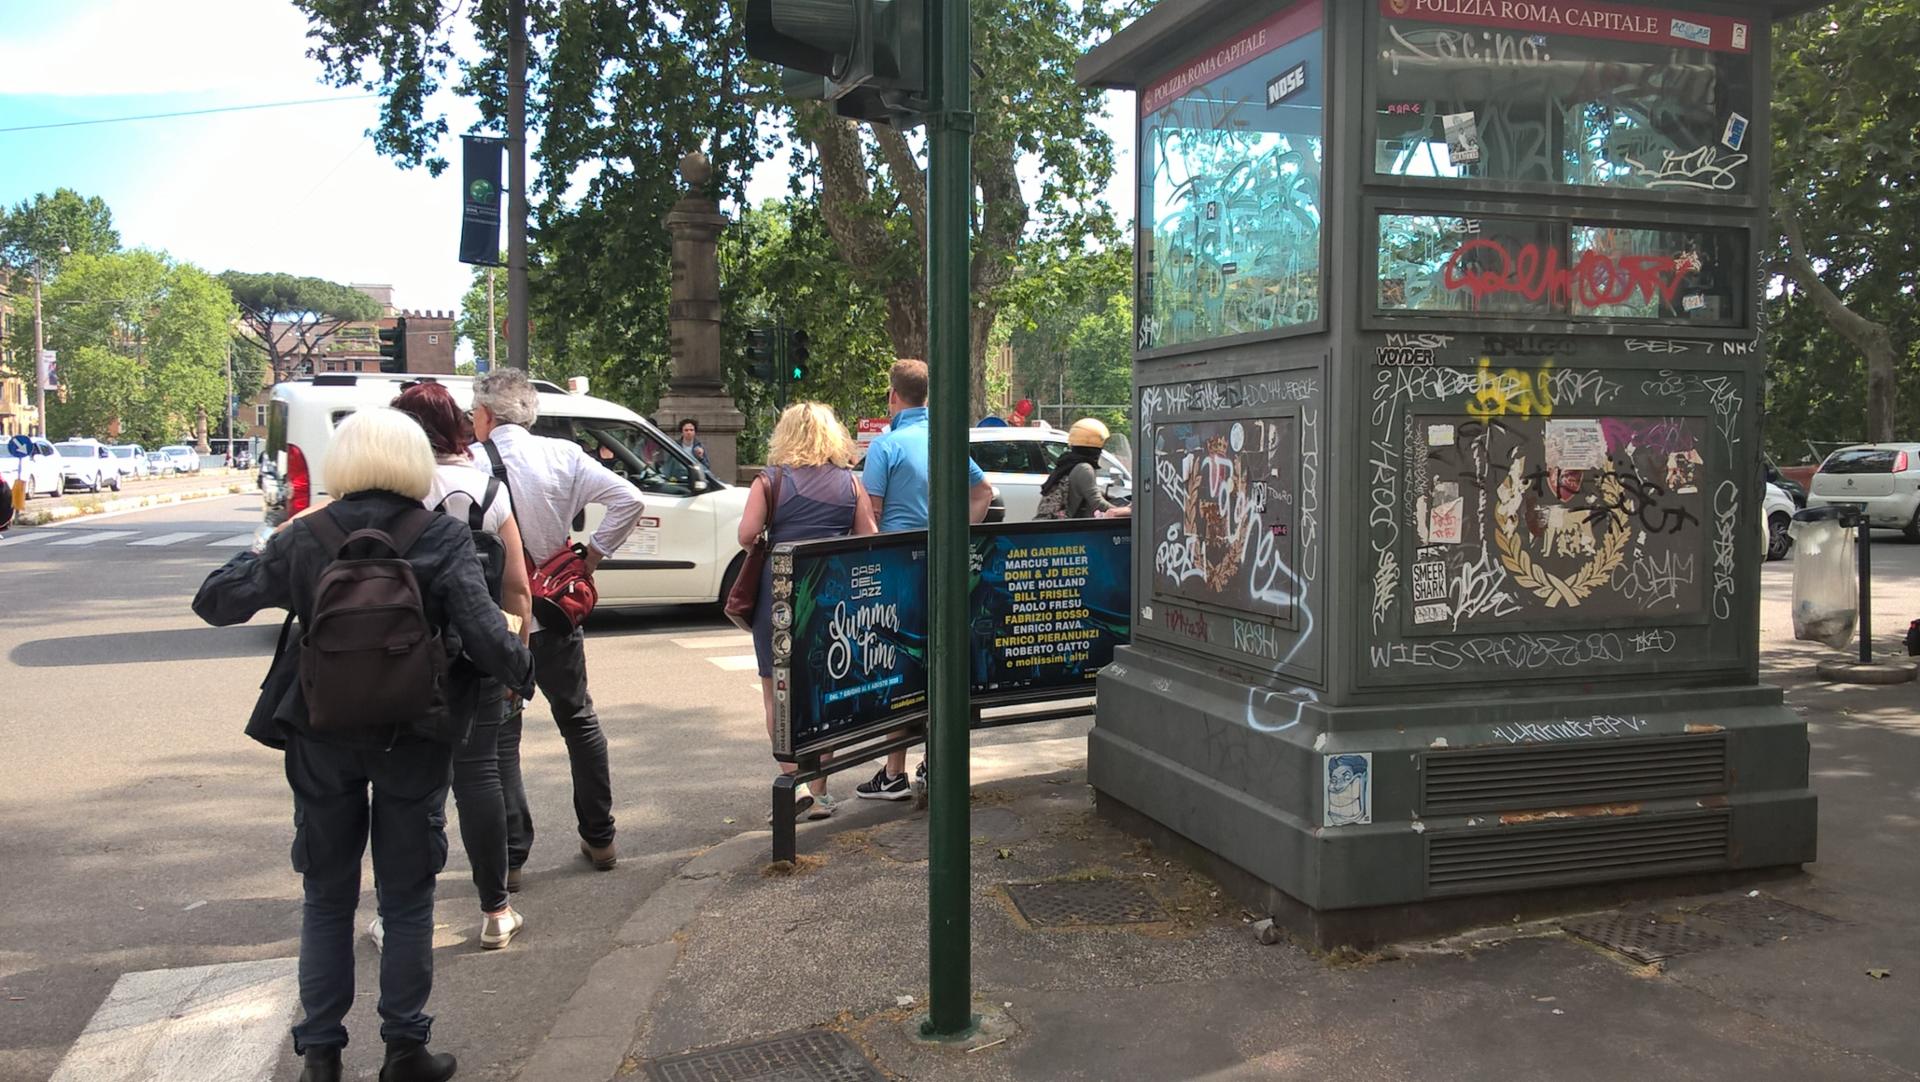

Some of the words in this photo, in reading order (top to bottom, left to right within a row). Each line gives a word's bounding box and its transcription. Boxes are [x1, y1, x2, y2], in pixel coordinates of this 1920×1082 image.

[1415, 0, 1497, 17] POLIZIA
[1500, 1, 1561, 25] ROMA
[1564, 8, 1658, 34] CAPITALE
[1154, 75, 1186, 103] POLIZIA
[1187, 59, 1216, 83] ROMA
[1217, 29, 1266, 67] CAPITALE
[1268, 64, 1305, 105] NOSE
[1007, 548, 1028, 559] JAN
[1031, 545, 1086, 557] GARBAREK
[851, 563, 881, 576] CASA
[1005, 558, 1048, 570] MARCUS
[1051, 556, 1088, 568] MILLER
[1004, 570, 1031, 581] DOMI
[1035, 569, 1042, 578] &
[1045, 568, 1058, 578] JD
[1062, 567, 1089, 576] BECK
[1413, 562, 1444, 583] SMEER
[851, 576, 881, 588] DEL
[1008, 581, 1035, 592] DAVE
[1038, 578, 1086, 589] HOLLAND
[851, 588, 882, 600] JAZZ
[1014, 592, 1037, 602] BILL
[1039, 589, 1080, 600] FRISELL
[1415, 581, 1446, 600] SHARK
[1012, 602, 1046, 613] PAOLO
[1049, 599, 1082, 610] FRESU
[1005, 612, 1052, 624] FABRIZIO
[1055, 609, 1089, 621] BOSSO
[1013, 623, 1052, 635] ENRICO
[1055, 620, 1081, 631] RAVA
[827, 600, 900, 680] Summer
[995, 635, 1035, 648] ENRICO
[1037, 629, 1099, 644] PIERANUNZI
[1005, 645, 1054, 657] ROBERTO
[1056, 641, 1090, 653] GATTO
[1016, 655, 1067, 667] moltissimi
[1070, 652, 1089, 662] altri
